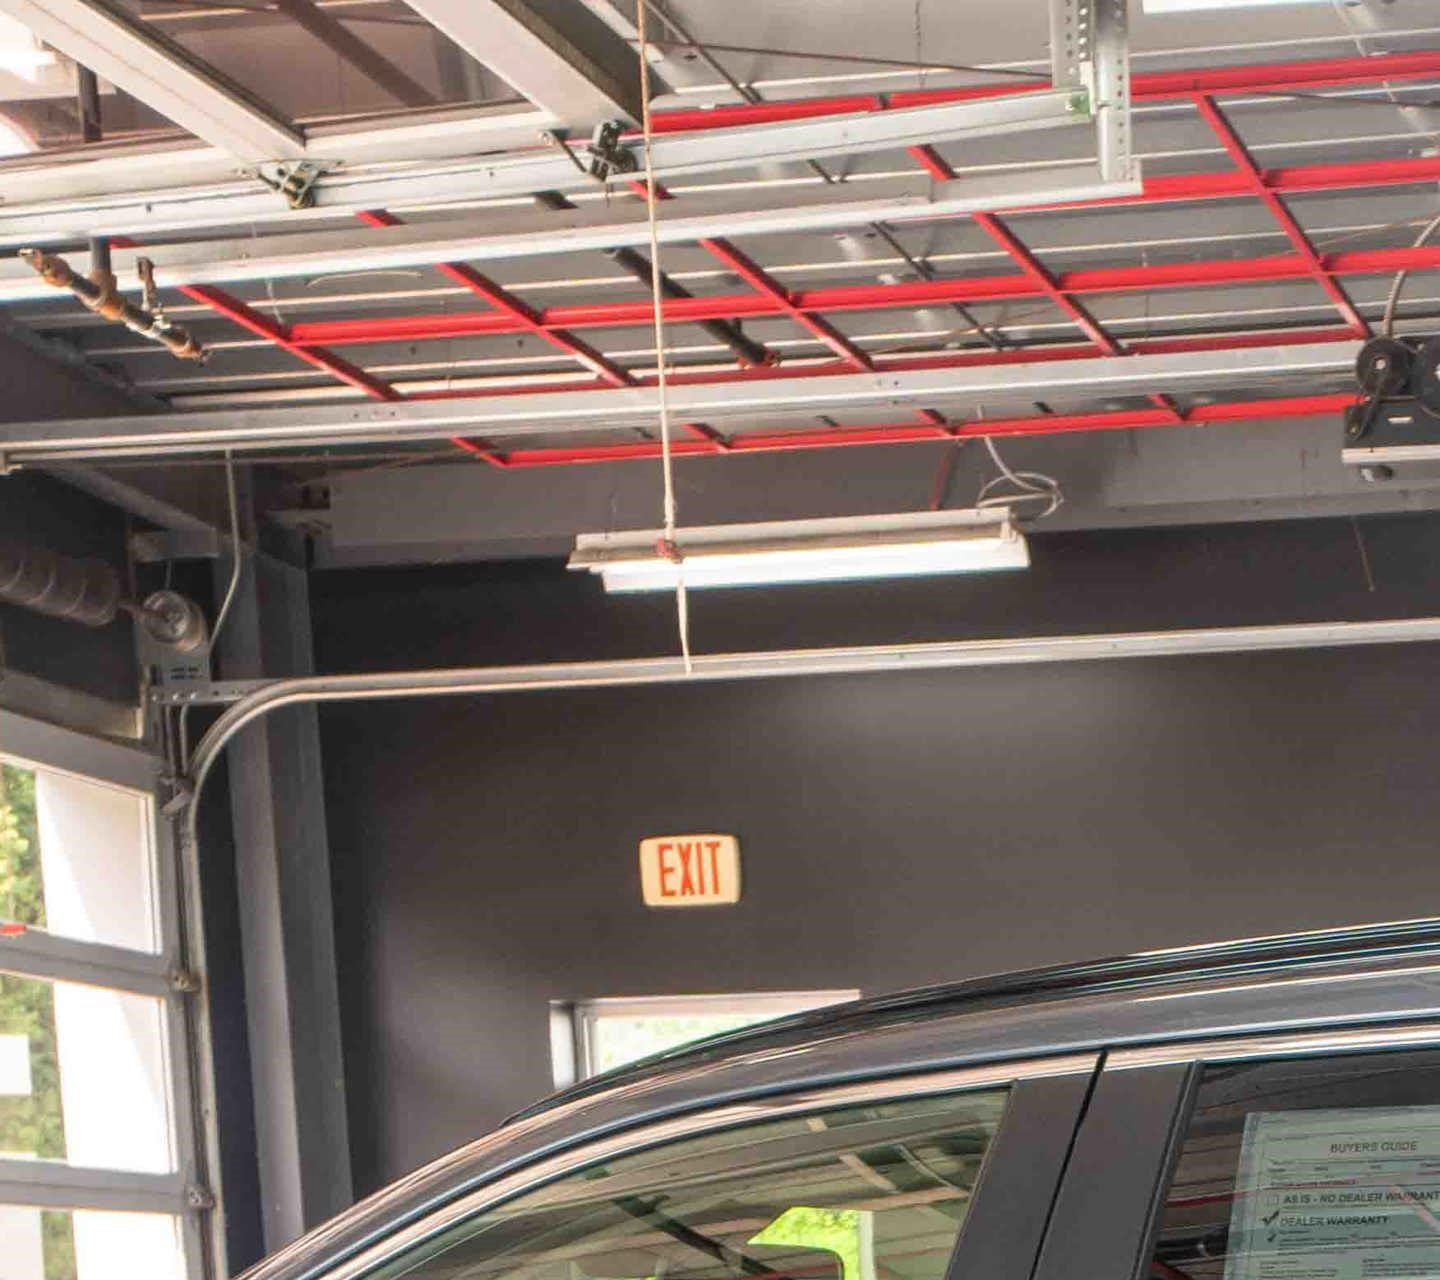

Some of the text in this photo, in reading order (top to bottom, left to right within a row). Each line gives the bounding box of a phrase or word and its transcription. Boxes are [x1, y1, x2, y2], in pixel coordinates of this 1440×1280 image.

[657, 841, 721, 897] EXIT
[1330, 1141, 1418, 1153] BUYERS GUIDE
[1320, 1193, 1336, 1203] NO
[1339, 1193, 1382, 1202] DEALER
[1281, 1217, 1325, 1227] DEALER
